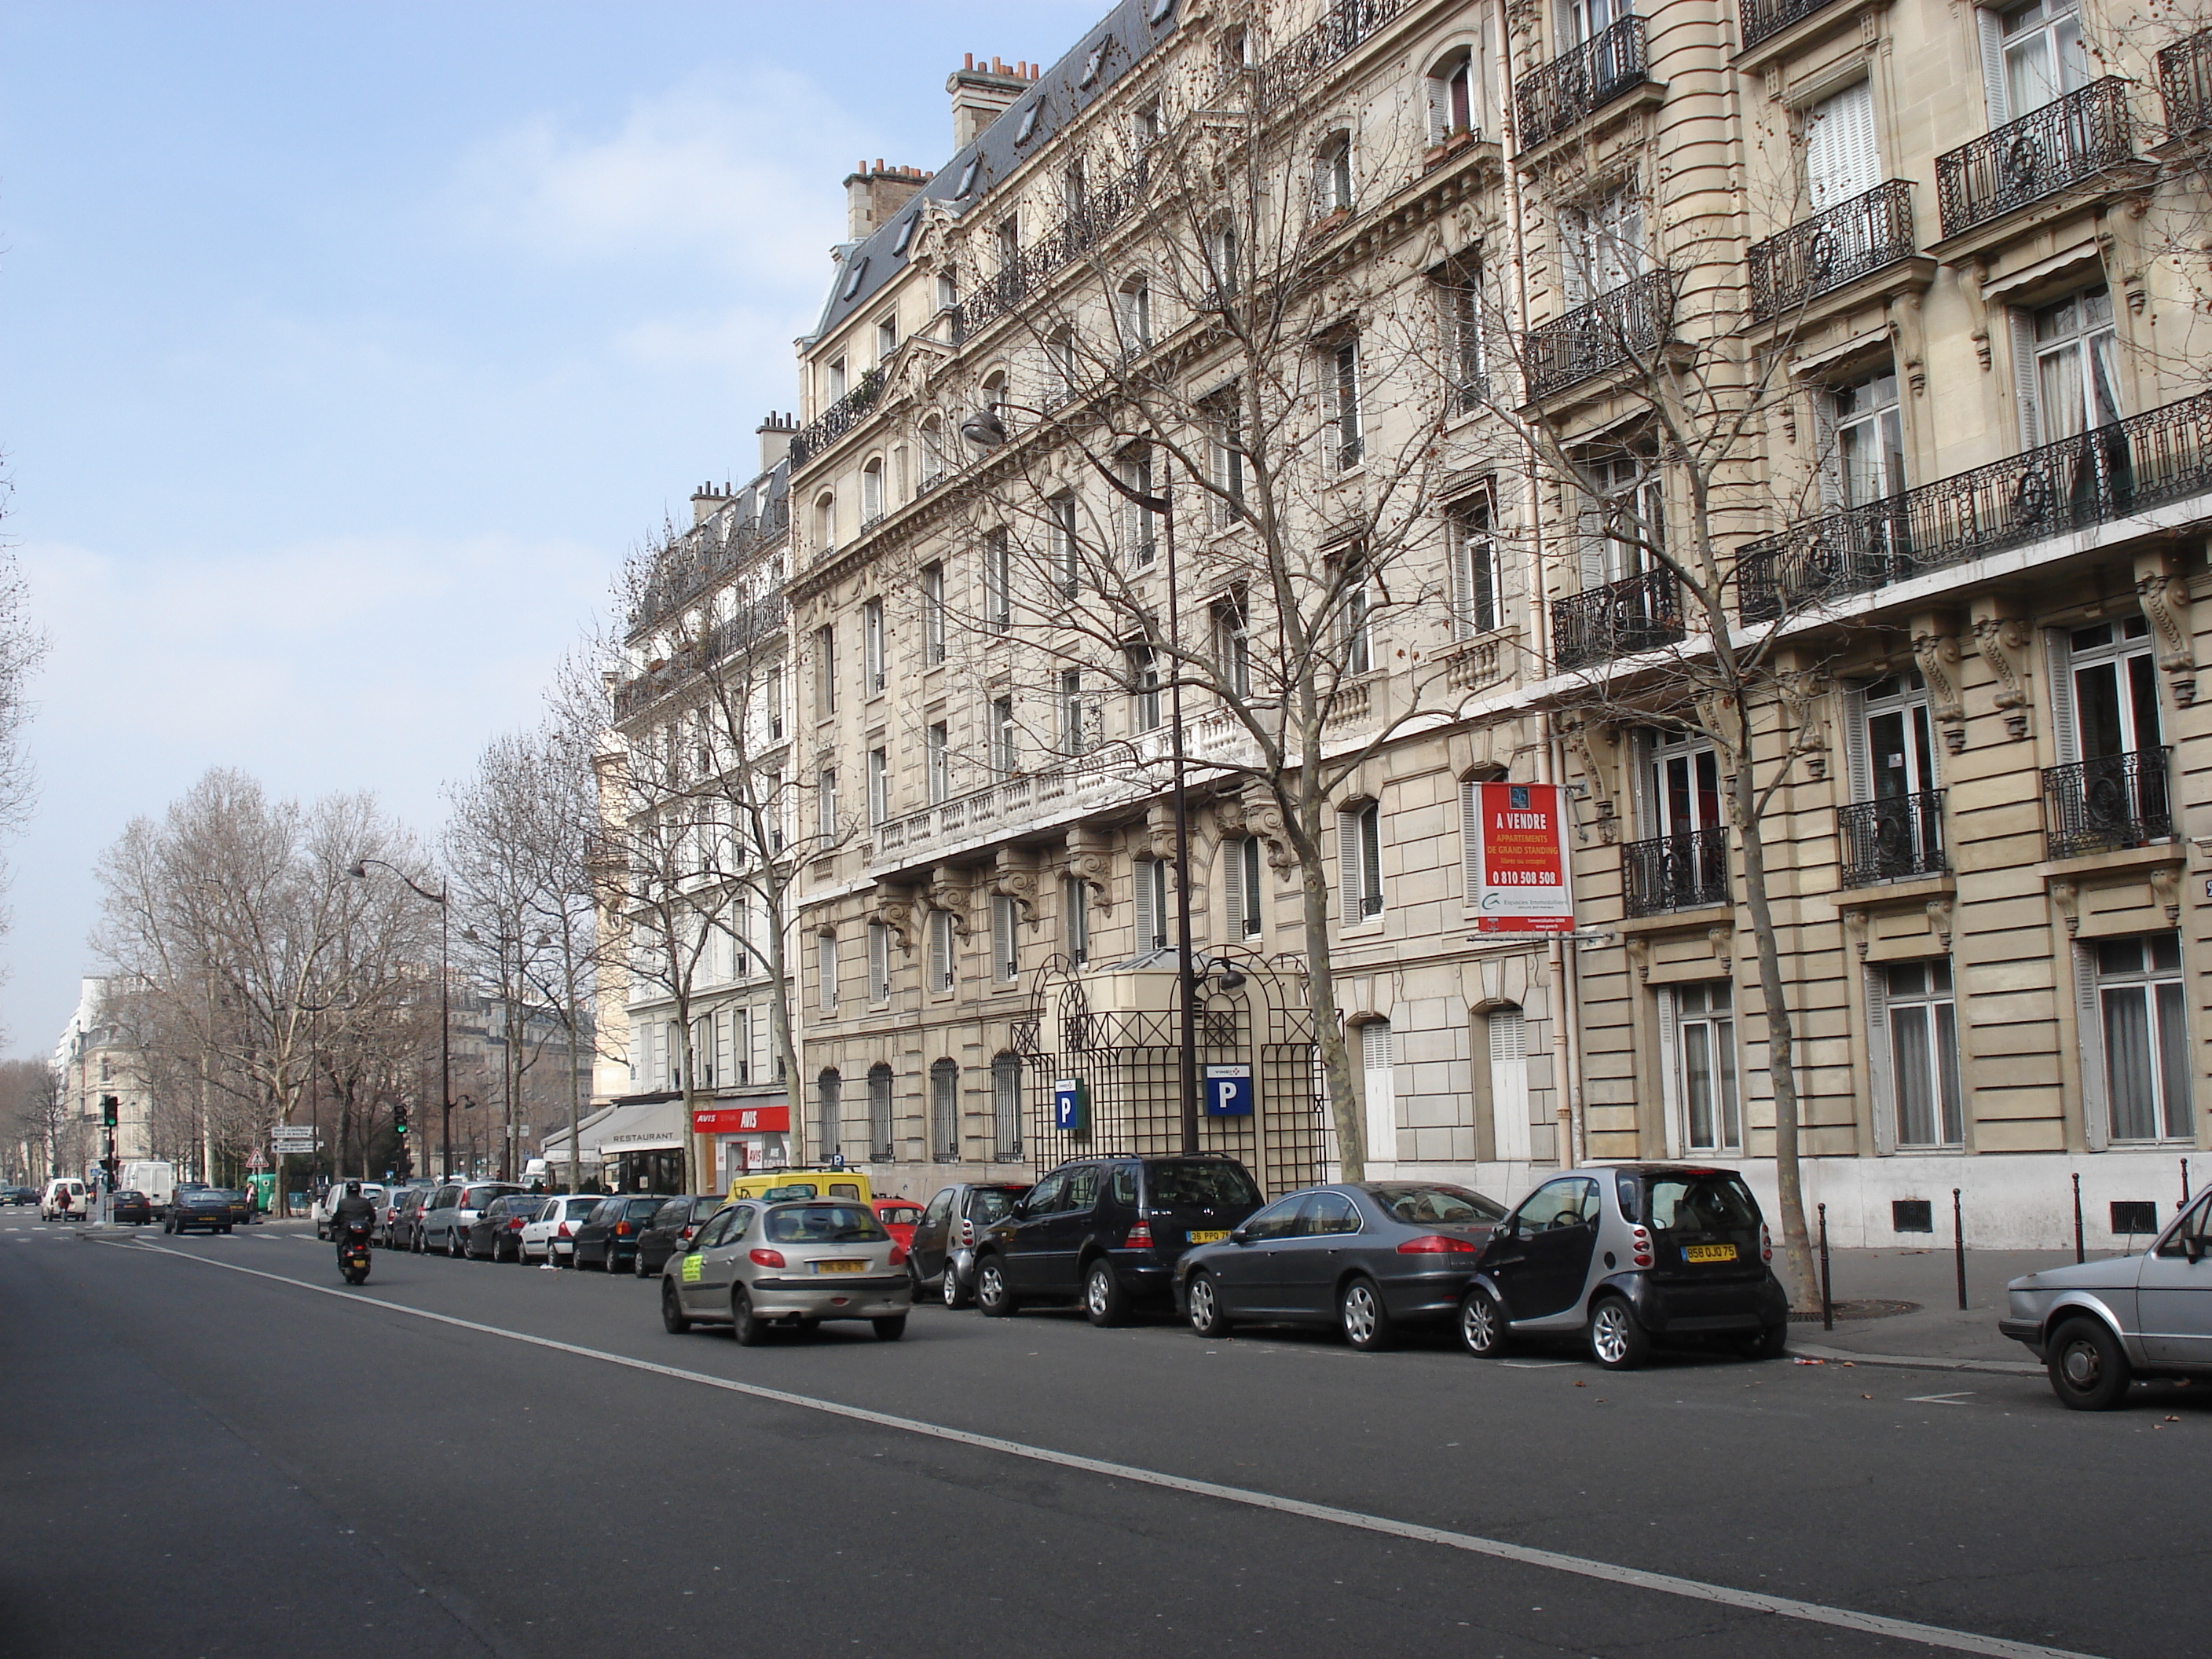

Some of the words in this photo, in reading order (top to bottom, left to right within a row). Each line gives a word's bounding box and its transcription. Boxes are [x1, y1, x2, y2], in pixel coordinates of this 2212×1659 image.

[1512, 788, 1527, 804] 26
[1496, 812, 1504, 830] A
[1506, 812, 1547, 830] VENDRE
[1496, 834, 1548, 843] APPARTEMENTS
[1487, 845, 1497, 854] DE
[1498, 846, 1523, 855] GRAND
[1524, 846, 1558, 855] STANDING
[1492, 870, 1500, 884] 0
[1501, 870, 1518, 884] 810
[1520, 871, 1537, 884] 508
[1539, 871, 1556, 884] 508
[1218, 1082, 1237, 1108] P
[1061, 1097, 1071, 1123] P
[697, 1114, 716, 1123] AVIS
[740, 1110, 757, 1129] AVIS
[613, 1132, 674, 1143] RESTAURANT
[749, 1149, 761, 1163] AVIS
[833, 1155, 842, 1166] P
[1204, 1232, 1219, 1240] PPQ
[1687, 1247, 1704, 1258] 858
[1705, 1247, 1722, 1258] QJQ
[1723, 1246, 1734, 1257] 75
